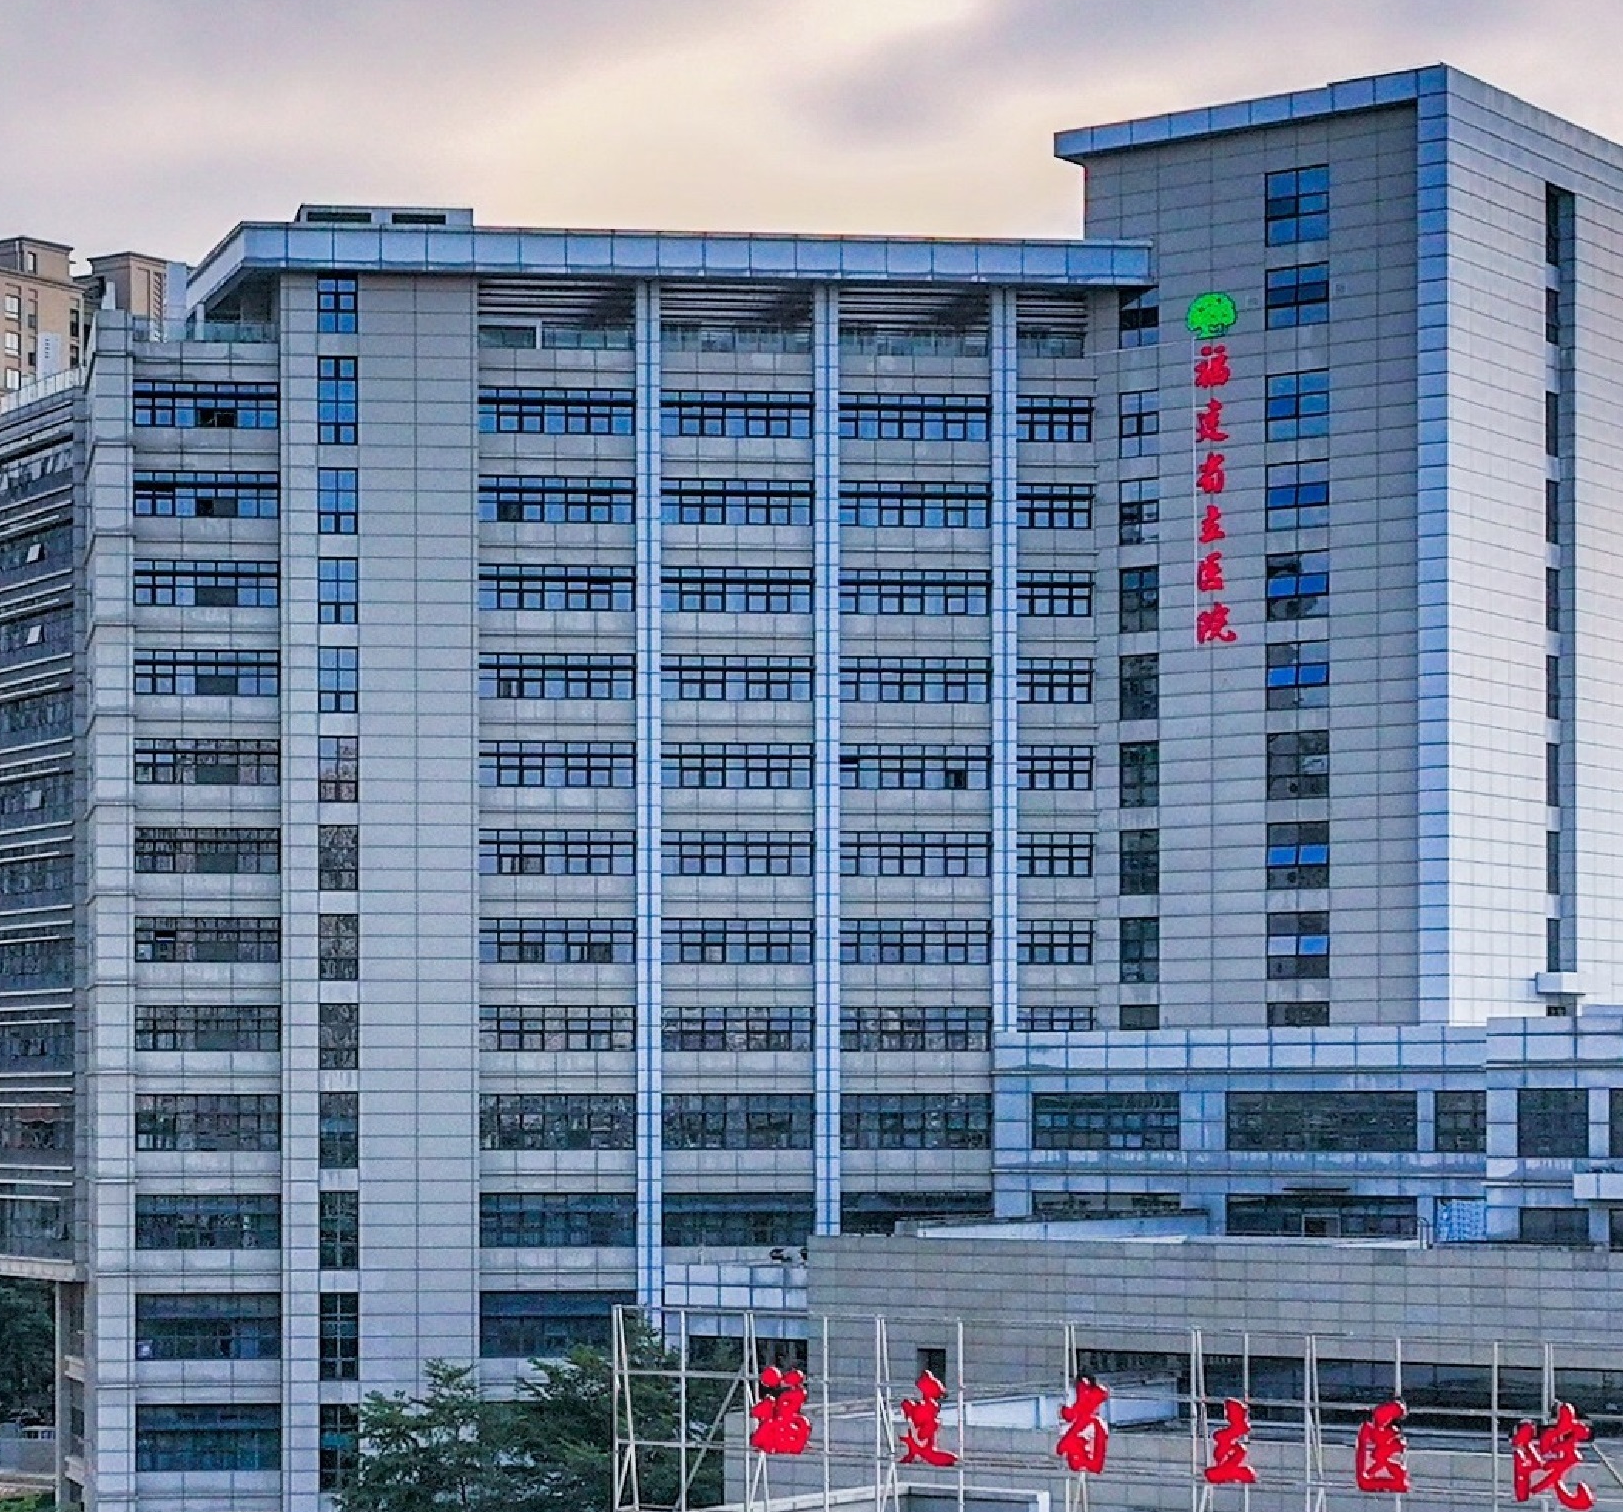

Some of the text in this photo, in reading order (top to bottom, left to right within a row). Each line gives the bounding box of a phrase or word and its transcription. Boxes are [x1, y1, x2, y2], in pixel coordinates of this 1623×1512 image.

[1195, 345, 1237, 644] 福建省立医院
[750, 1365, 1595, 1512] 福建省立医院
